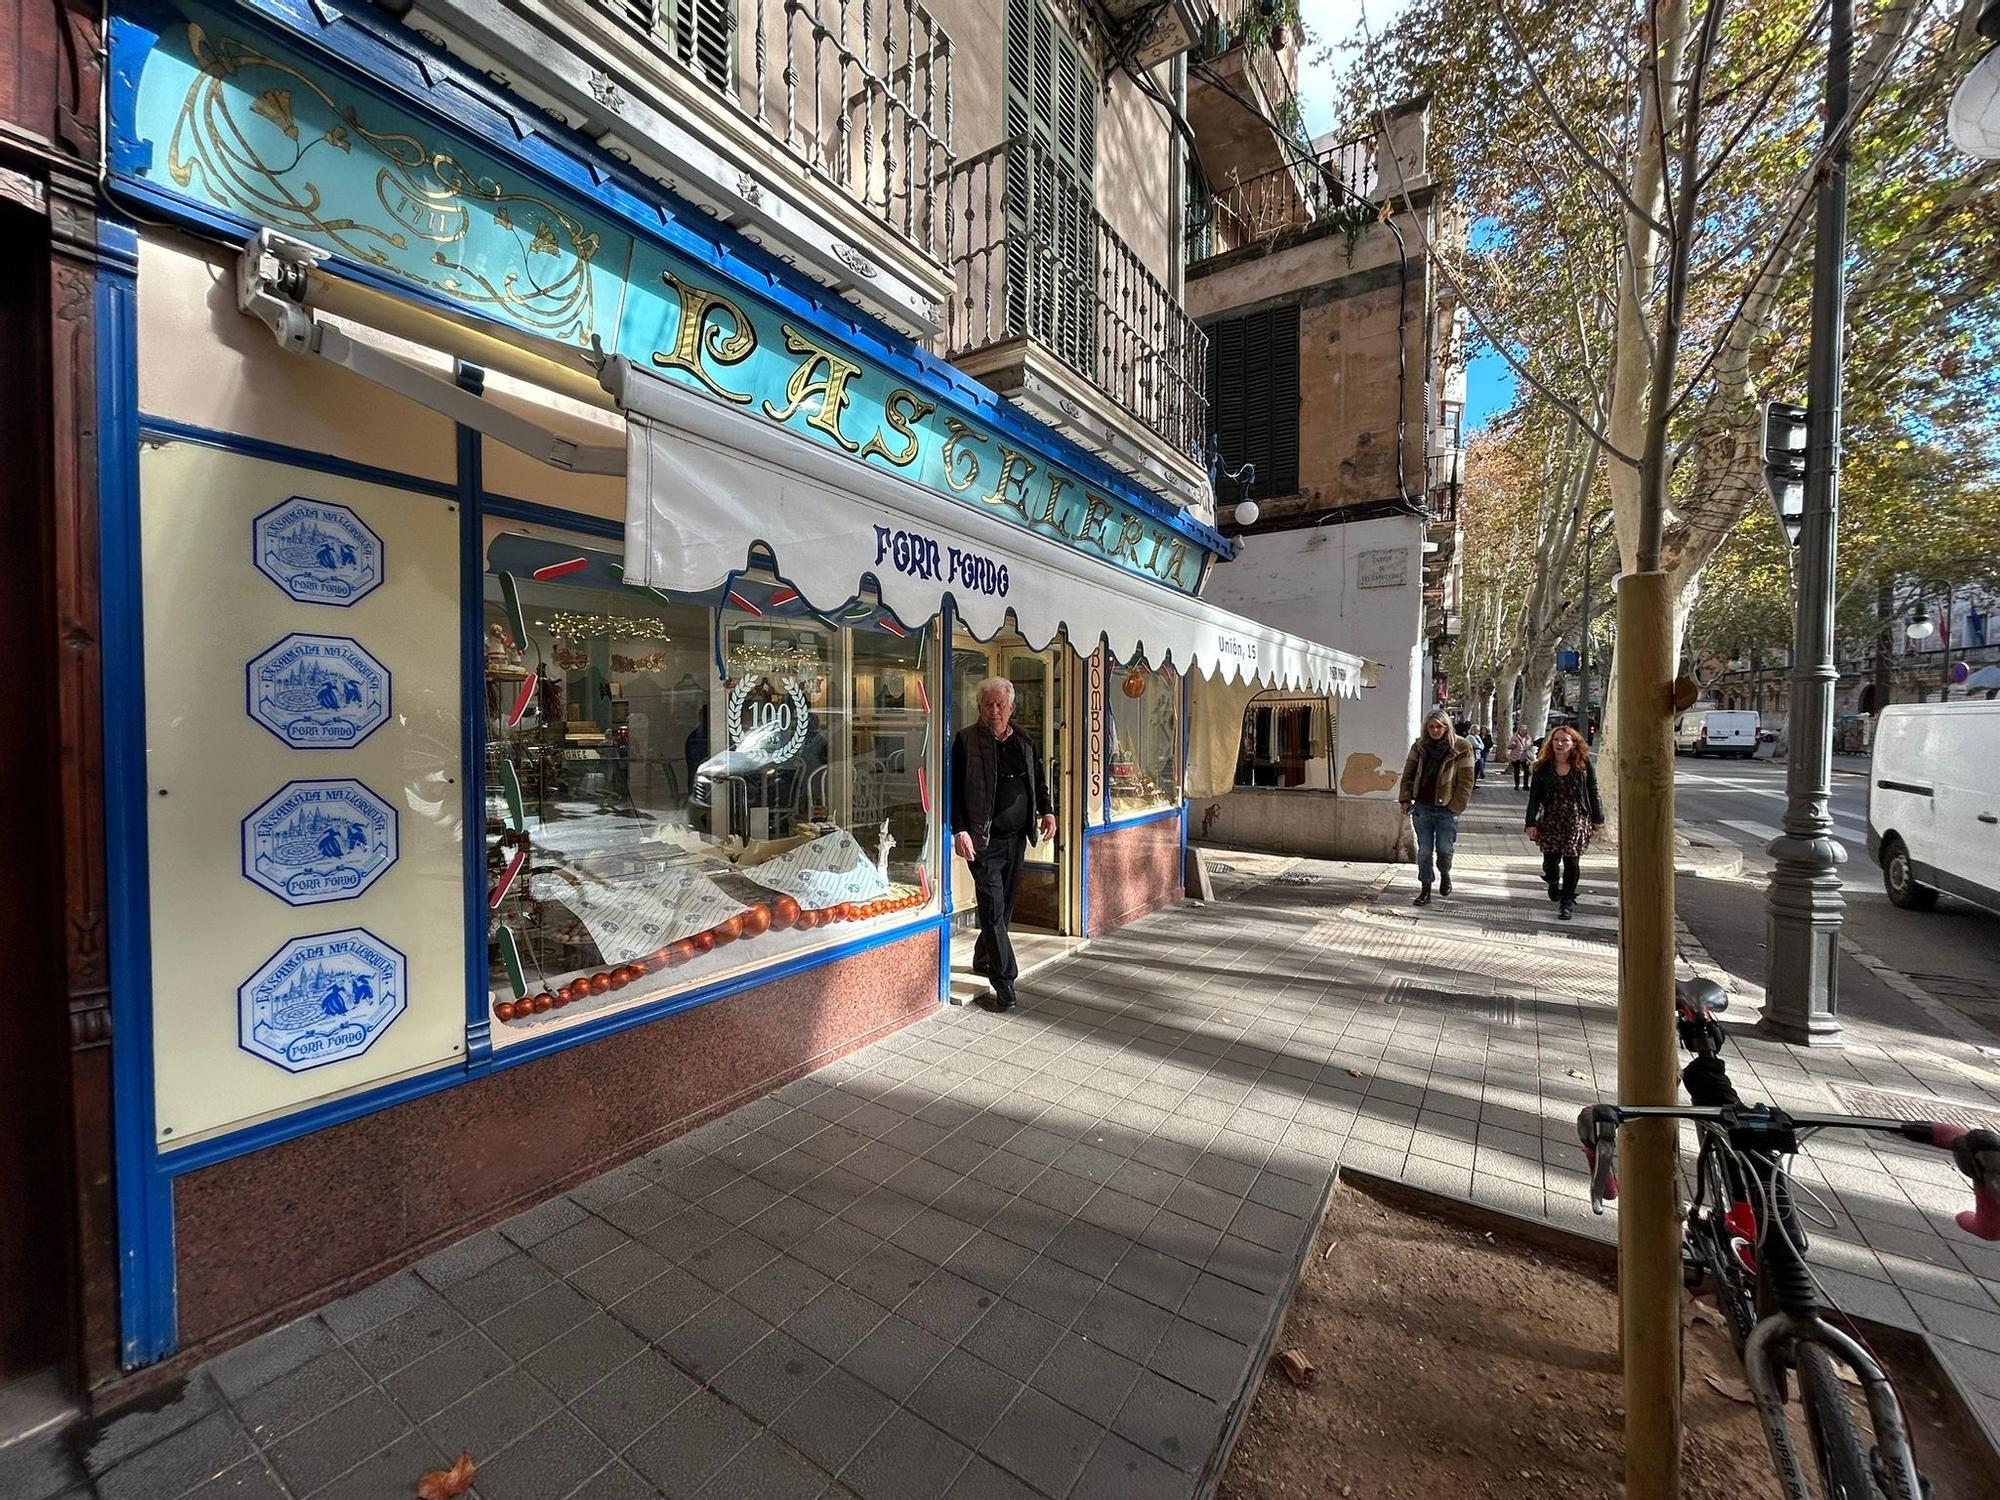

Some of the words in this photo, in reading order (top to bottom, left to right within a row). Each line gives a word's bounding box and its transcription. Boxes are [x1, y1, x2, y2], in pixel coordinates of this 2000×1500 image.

[397, 197, 445, 232] 1911
[652, 270, 1188, 587] PASTELERIA
[873, 524, 942, 581] FORN
[947, 546, 1009, 597] FONDO
[1247, 645, 1256, 659] 15
[748, 702, 791, 731] 100
[1090, 647, 1101, 796] BOMBONS
[258, 791, 321, 837] ENSAIMADA
[291, 880, 320, 891] FORN
[324, 875, 356, 887] FONDO
[256, 946, 324, 1003] ENSAIMADA
[329, 941, 393, 981] MALLORQUINA
[291, 1041, 324, 1057] FORN
[327, 1031, 362, 1048] FONDO
[1771, 1427, 1796, 1482] SUPER
